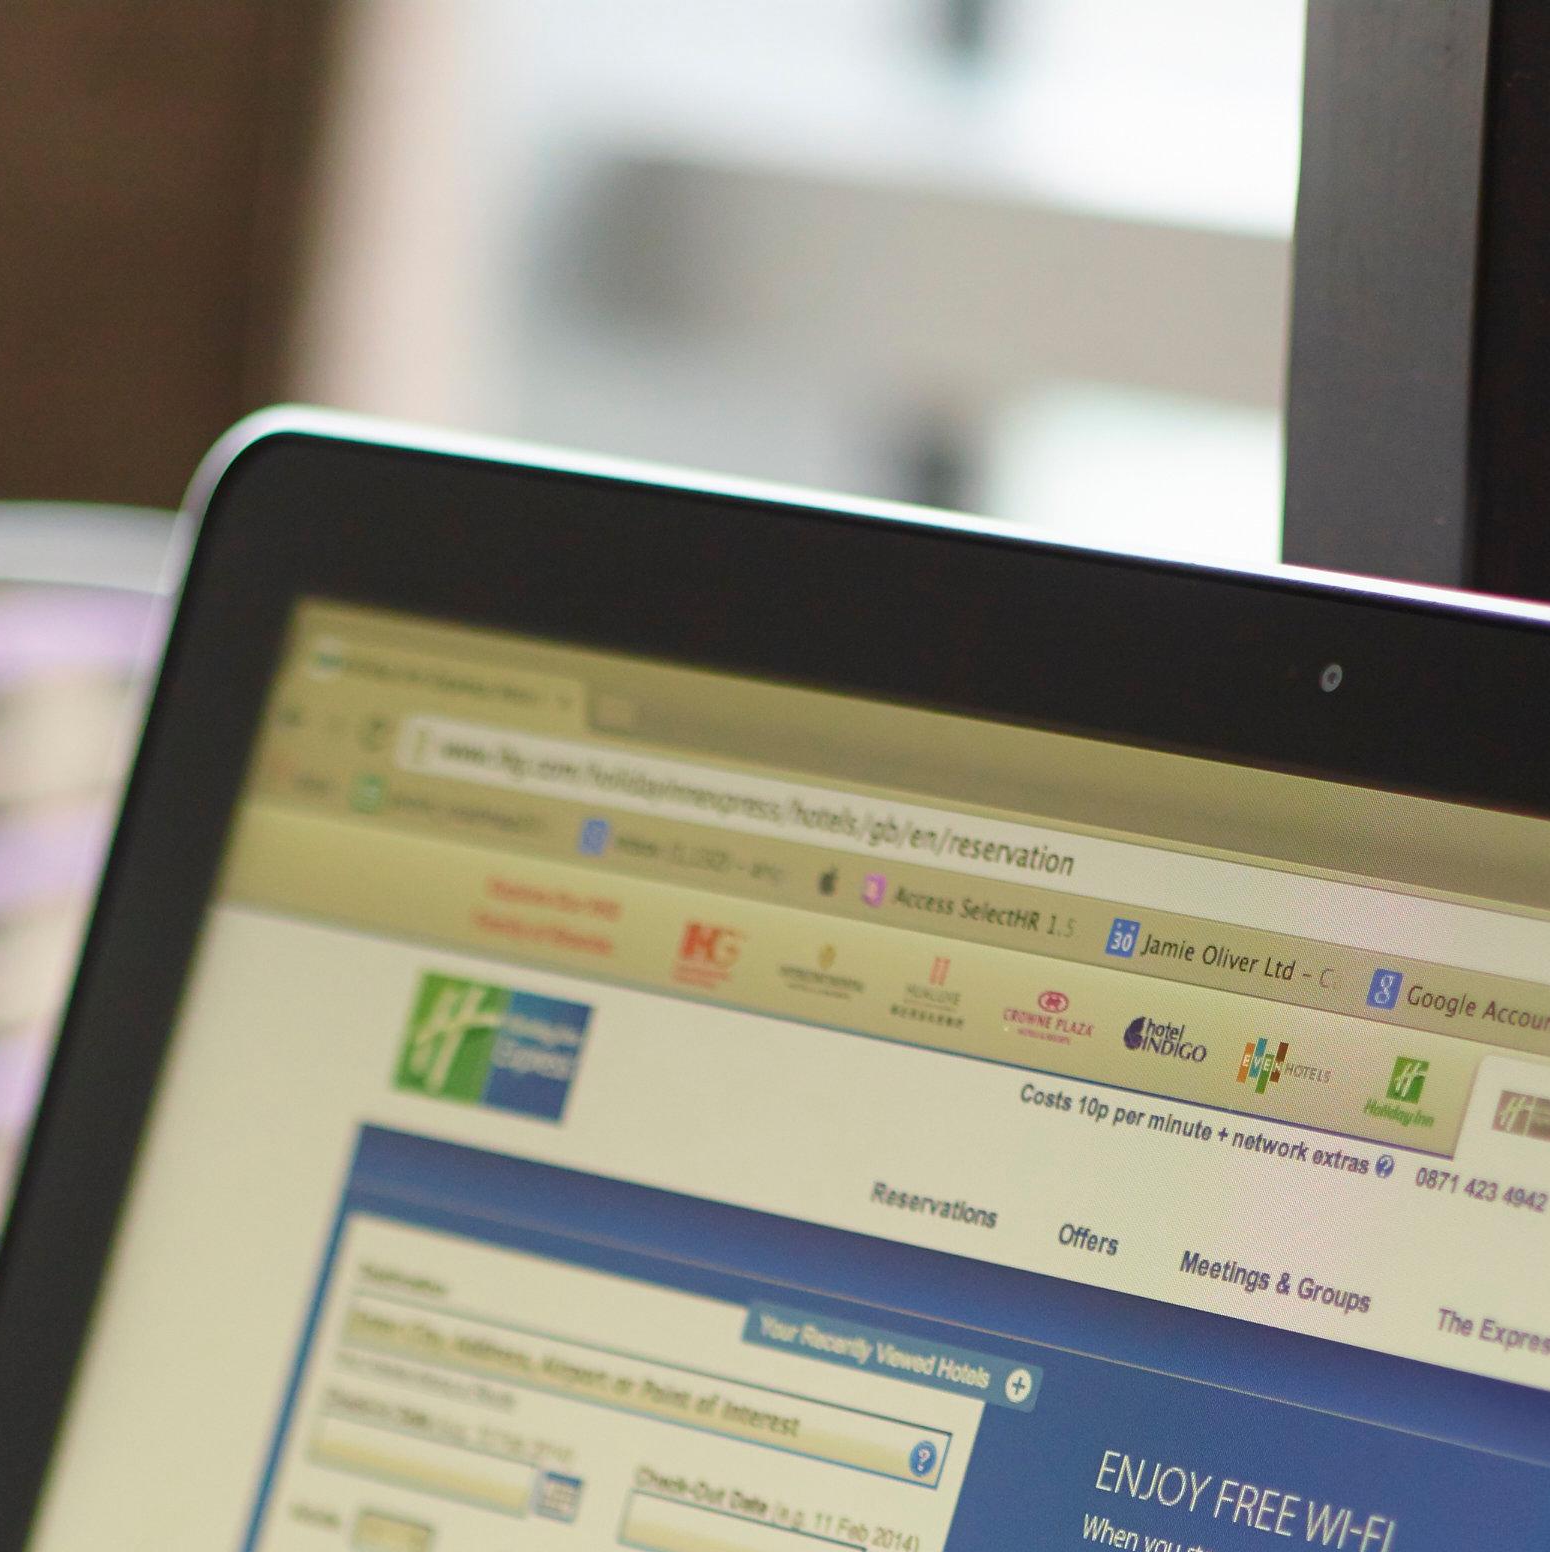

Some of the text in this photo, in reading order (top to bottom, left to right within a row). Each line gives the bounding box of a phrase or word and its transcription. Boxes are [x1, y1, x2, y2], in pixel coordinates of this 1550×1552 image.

[893, 885, 954, 917] Access
[960, 898, 1039, 932] SelectHR
[1111, 931, 1133, 952] 30
[1139, 934, 1294, 981] Jamie Oliver Ltd
[1003, 1008, 1052, 1030] CROWNE
[1056, 1017, 1095, 1038] PLAZA
[1407, 985, 1475, 1018] Google
[1142, 1037, 1207, 1063] INDIGO
[1146, 1018, 1185, 1041] hotel
[1285, 1064, 1331, 1084] HOTELS
[1020, 1082, 1073, 1112] Costs
[1078, 1096, 1109, 1125] 10p
[1113, 1106, 1145, 1129] per
[1148, 1109, 1213, 1142] minute
[1232, 1129, 1307, 1162] network
[1312, 1148, 1369, 1175] extras
[871, 1182, 997, 1229] Reservations
[1415, 1167, 1549, 1214] 0871 423 4942
[1058, 1224, 1118, 1257] Offers
[1179, 1250, 1372, 1314] Meetings & Groups
[1437, 1307, 1473, 1338] The
[760, 1314, 990, 1389] Your Recently Viewed Hotels
[696, 1394, 720, 1416] of
[722, 1400, 800, 1437] Interest
[1096, 1450, 1212, 1512] ENJOY
[1213, 1479, 1301, 1537] FREE
[729, 1491, 768, 1517] Date
[814, 1511, 833, 1530] 11
[836, 1516, 869, 1543] Feb
[1082, 1513, 1139, 1552] When
